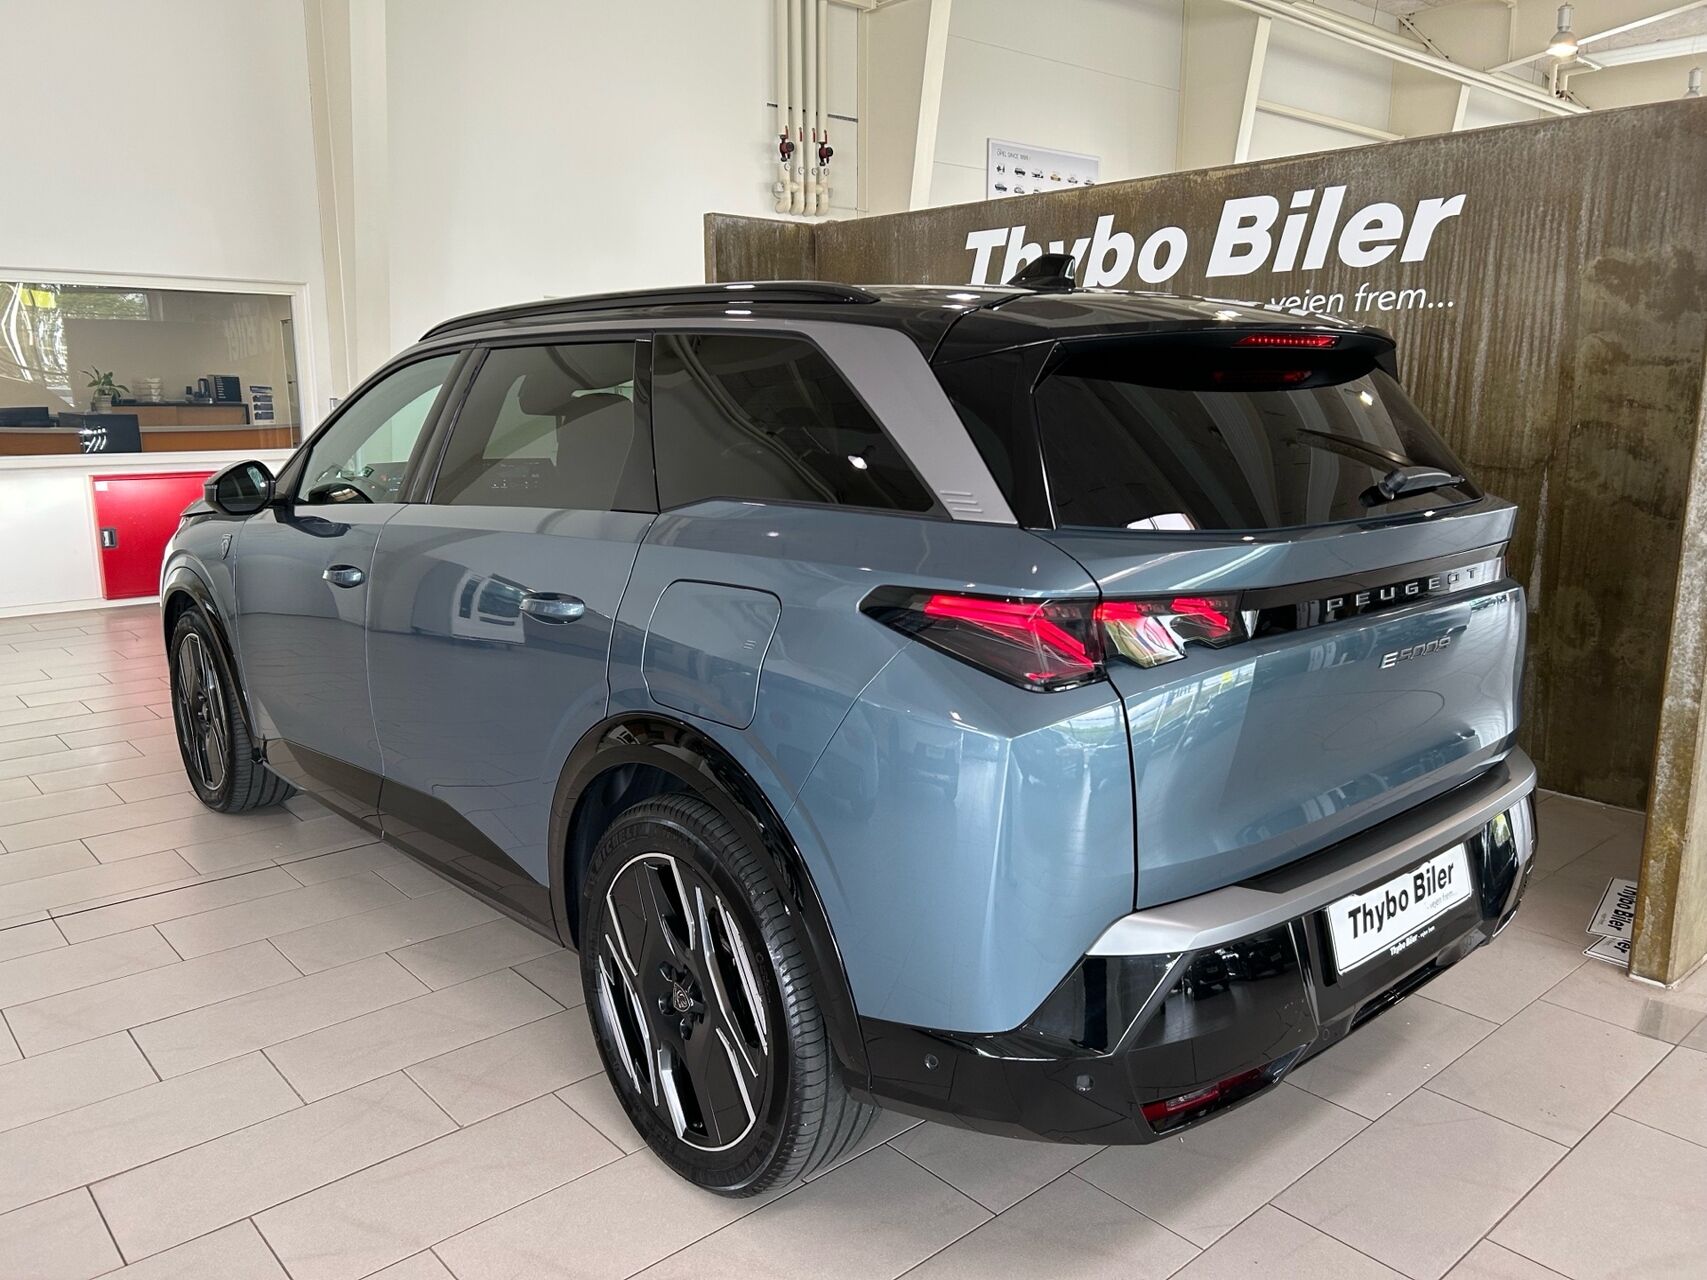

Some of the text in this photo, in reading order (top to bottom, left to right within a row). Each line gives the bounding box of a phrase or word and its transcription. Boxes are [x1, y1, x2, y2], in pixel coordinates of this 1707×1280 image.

[1205, 185, 1467, 278] Biler
[1326, 567, 1478, 613] PEUGEOT
[1347, 889, 1409, 939] Thybo
[1413, 862, 1454, 904] Biler
